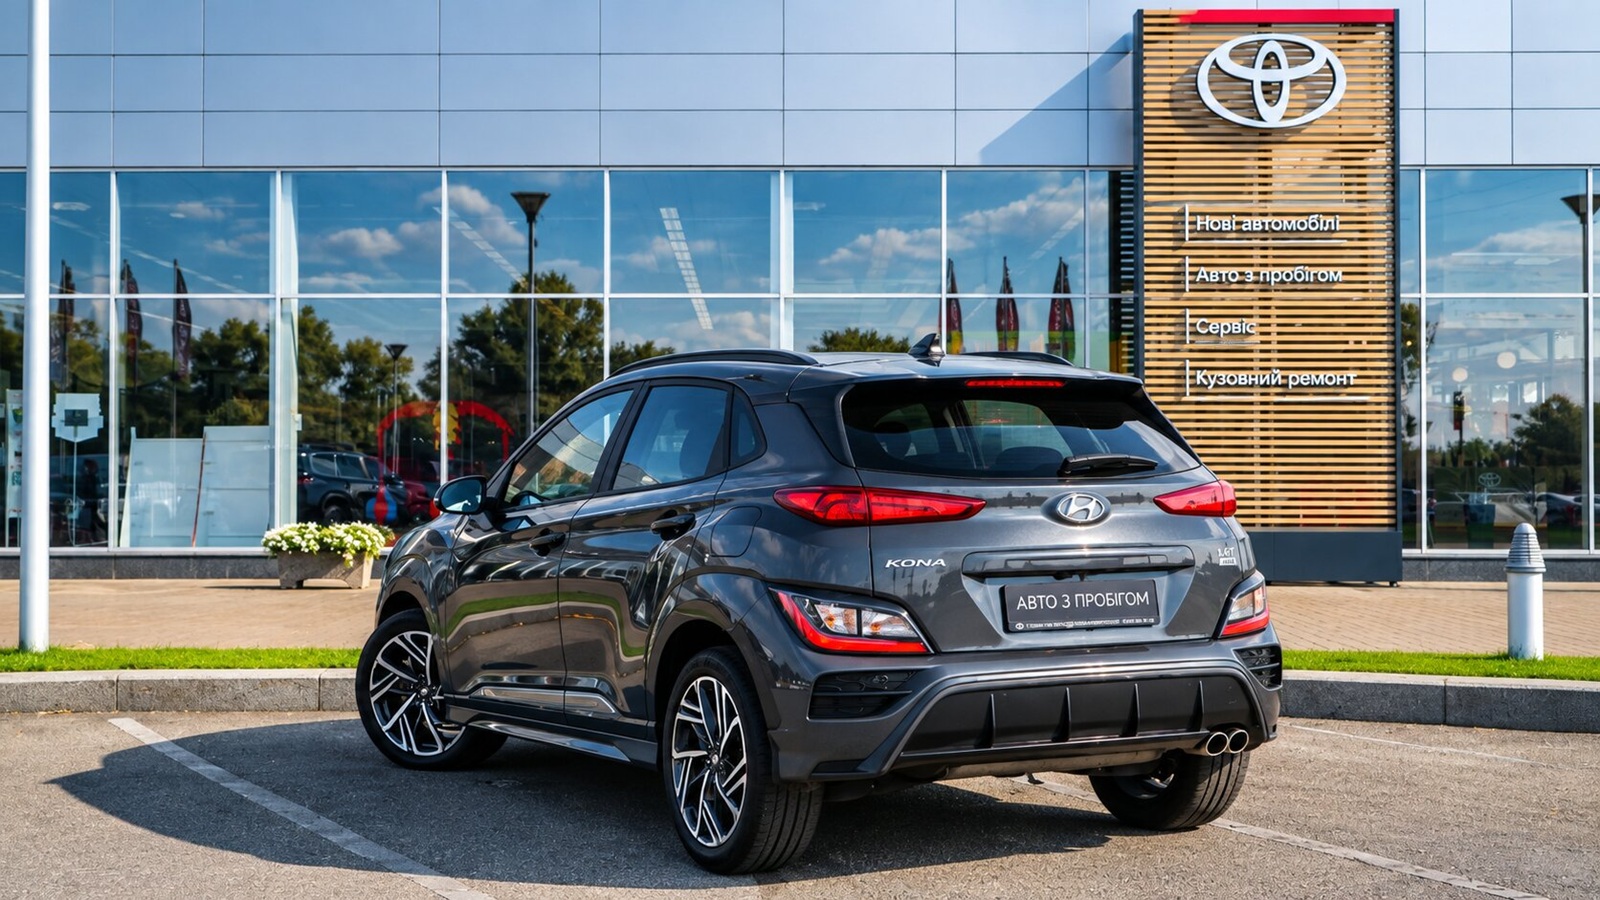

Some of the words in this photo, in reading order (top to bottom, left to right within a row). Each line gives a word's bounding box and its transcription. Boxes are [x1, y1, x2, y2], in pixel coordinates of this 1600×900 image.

[1196, 215, 1236, 231] Нові
[1241, 214, 1340, 231] автомобілі
[1196, 266, 1239, 282] Авто
[1244, 272, 1253, 282] з
[1260, 266, 1342, 286] пробігом
[1196, 318, 1256, 337] Сервіс
[1196, 369, 1282, 389] Кузовний
[1288, 372, 1357, 389] ремонт
[885, 558, 946, 568] KONA
[1016, 594, 1057, 611] АВТО
[1075, 591, 1150, 608] ПРОБІГОМ
